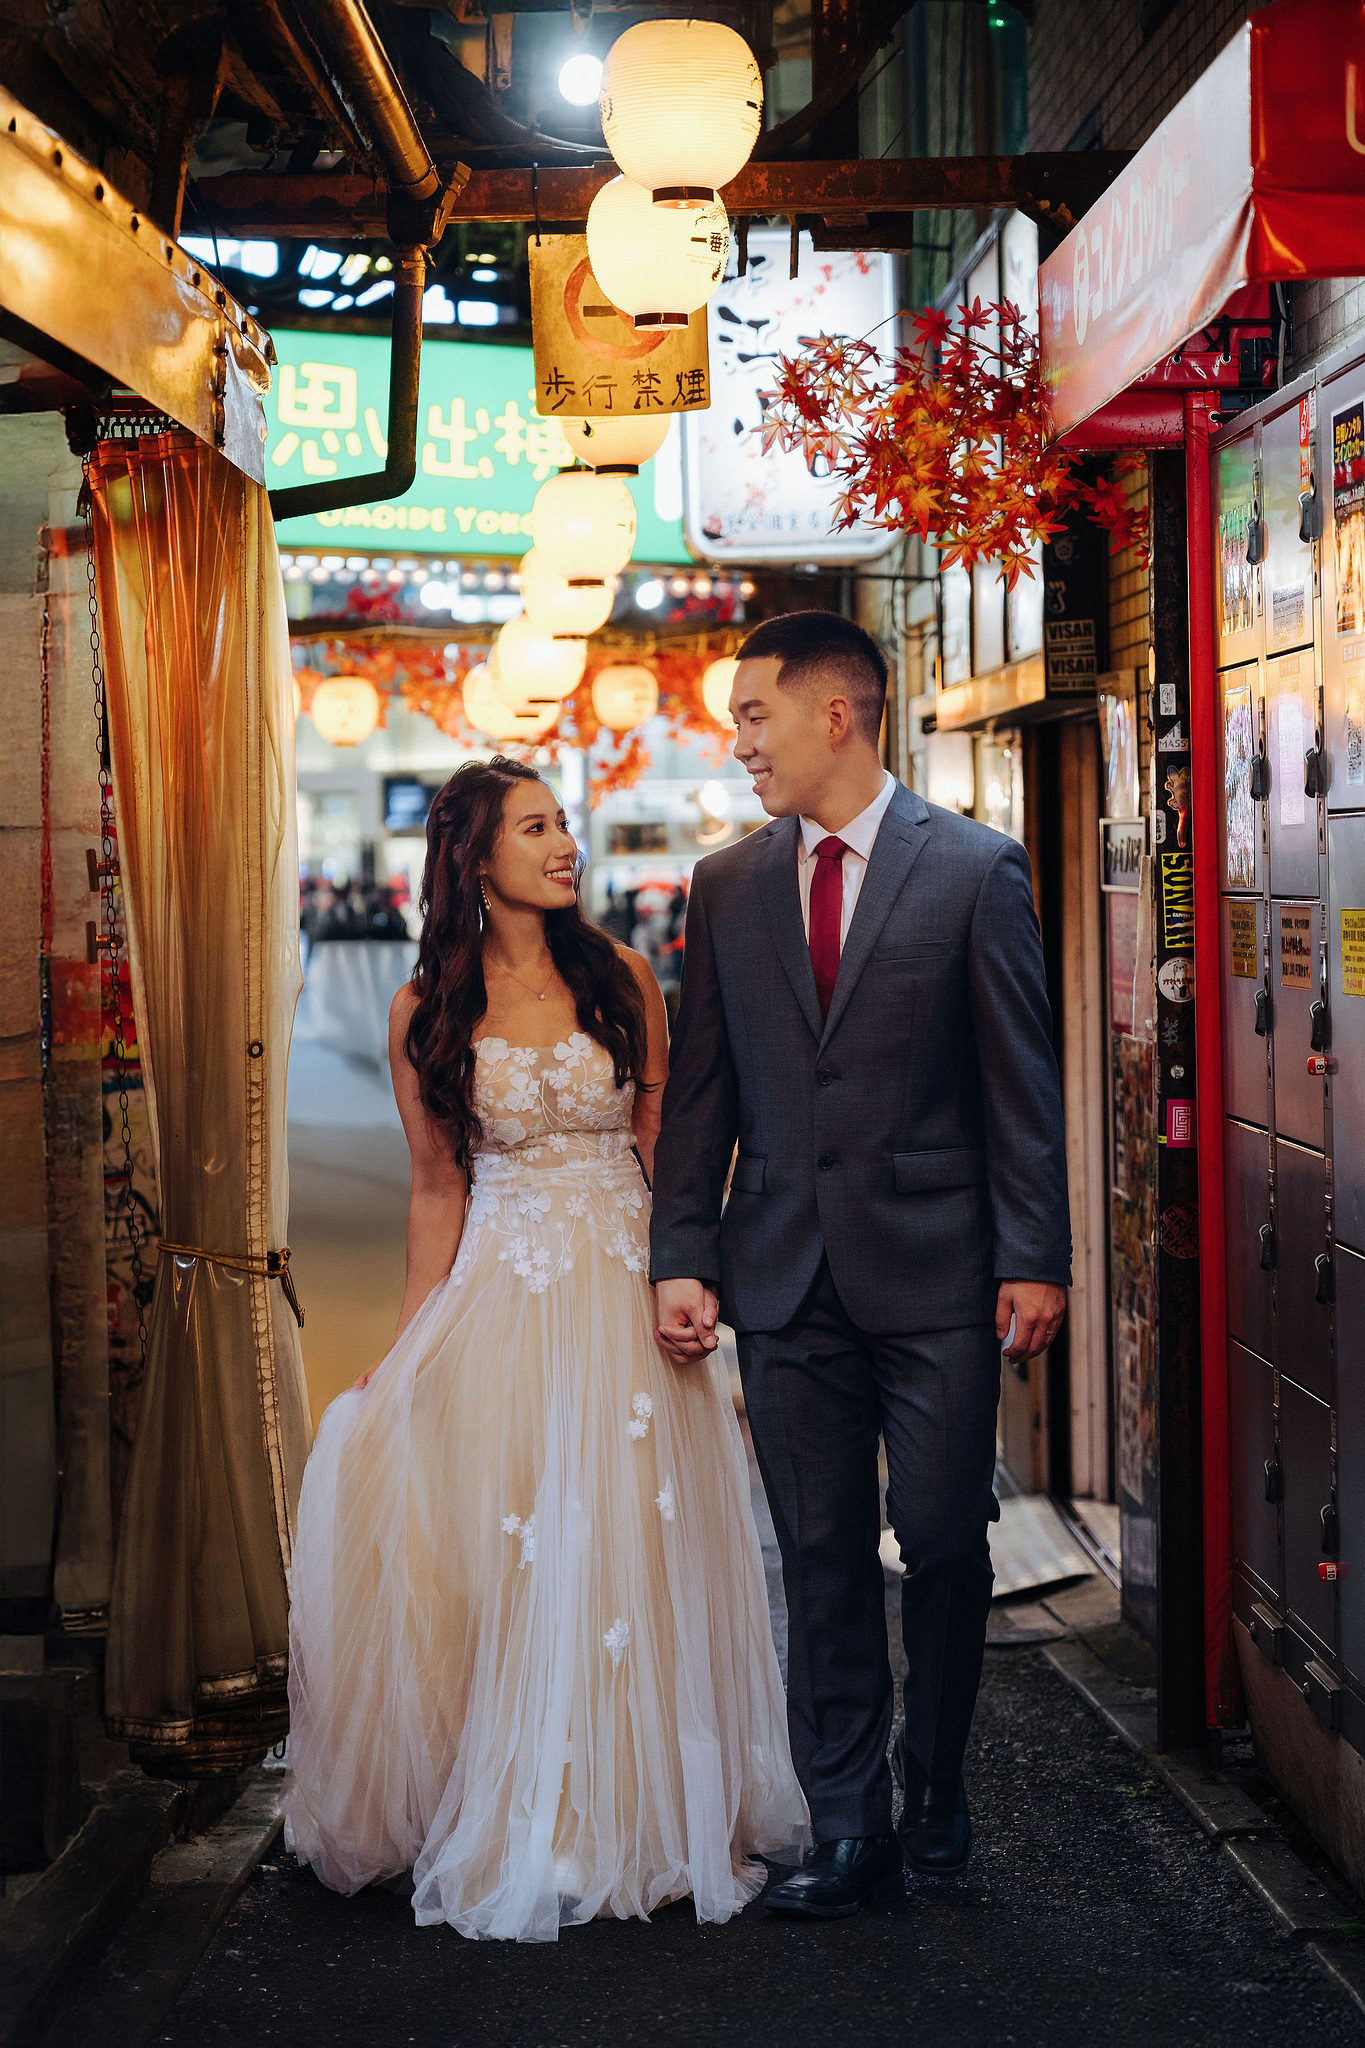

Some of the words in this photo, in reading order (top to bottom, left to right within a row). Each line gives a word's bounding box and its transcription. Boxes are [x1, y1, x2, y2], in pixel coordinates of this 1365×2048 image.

[1091, 135, 1190, 322] コインロッカー
[542, 366, 706, 411] 歩行禁煙
